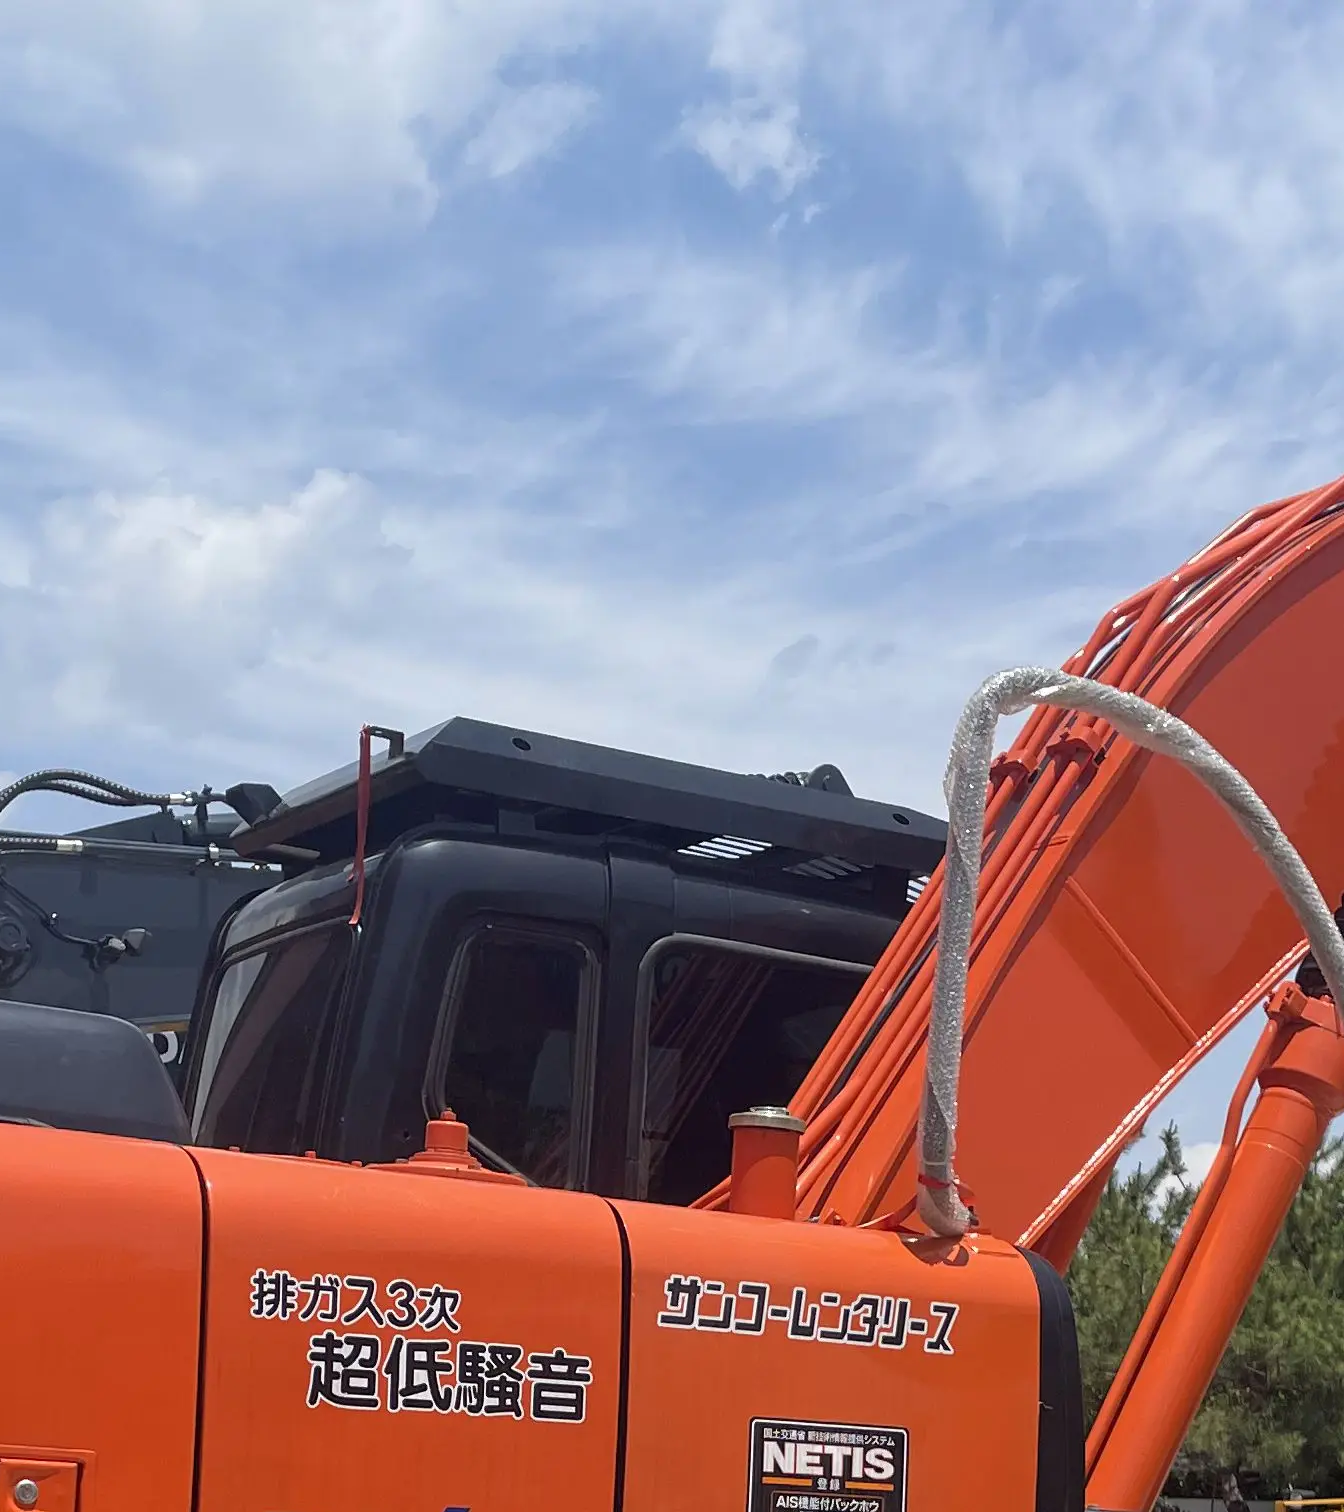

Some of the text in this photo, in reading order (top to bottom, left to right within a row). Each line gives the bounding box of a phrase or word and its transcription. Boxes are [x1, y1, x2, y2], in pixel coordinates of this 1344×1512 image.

[251, 1269, 460, 1331] 排ガス3次
[658, 1275, 958, 1353] サンコーレンタリース
[307, 1331, 591, 1422] 超低騒音
[763, 1441, 895, 1480] NETIS
[776, 1495, 879, 1512] AIS機能付バックホウ
